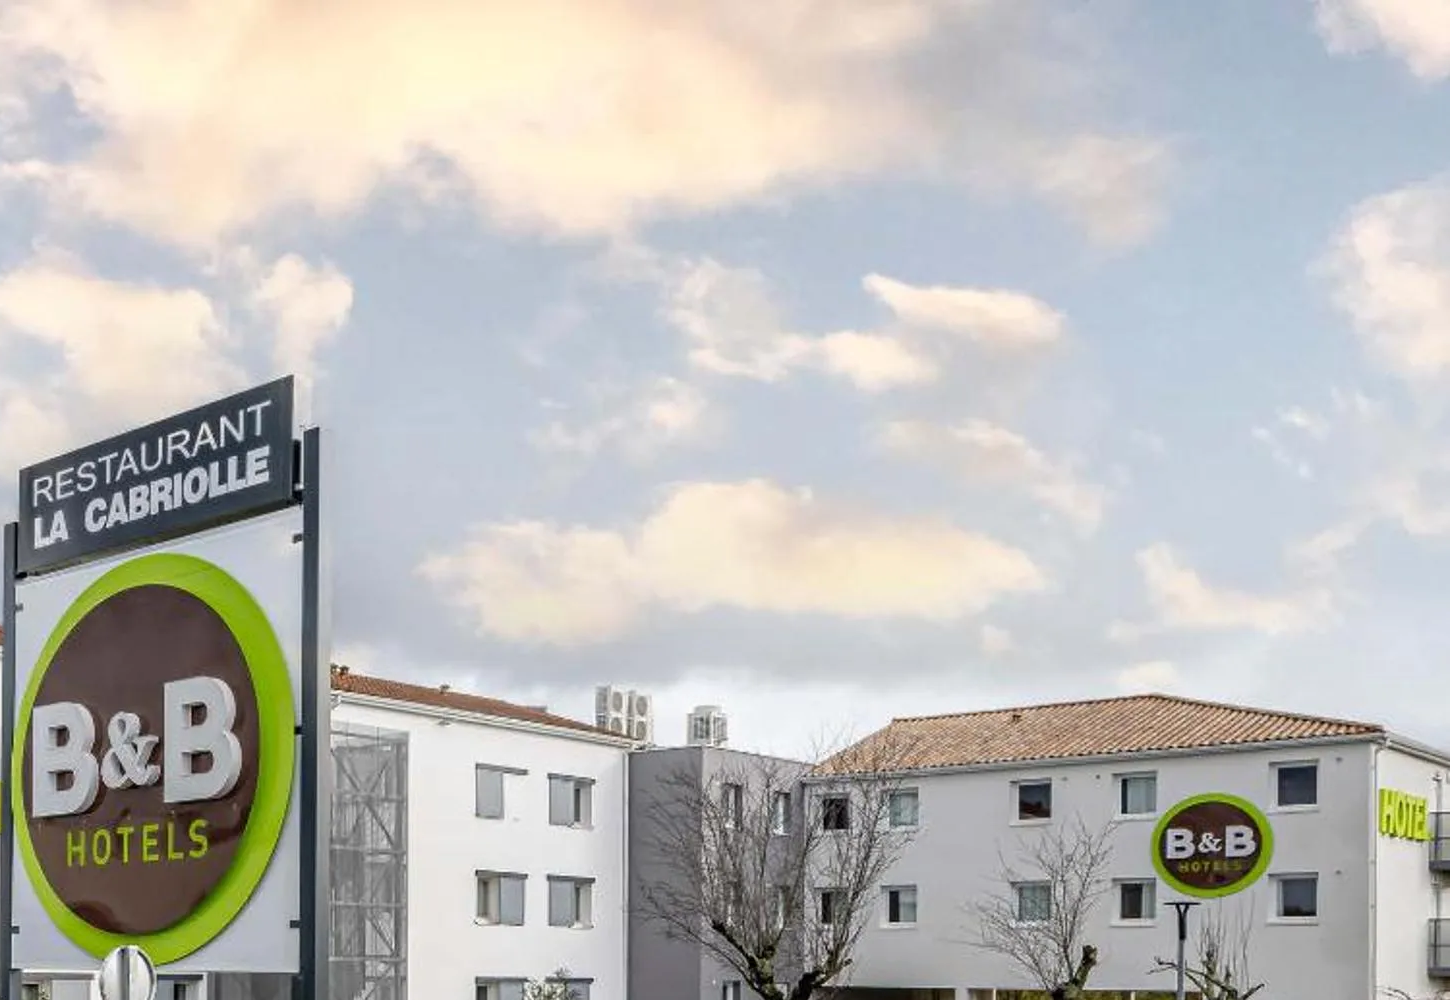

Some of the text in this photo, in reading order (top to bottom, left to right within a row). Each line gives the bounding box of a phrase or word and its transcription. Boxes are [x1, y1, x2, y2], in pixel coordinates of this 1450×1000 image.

[33, 400, 272, 507] RESTAURANT
[33, 445, 270, 550] LA CABRIOLLE
[32, 676, 243, 818] B&B
[67, 819, 209, 867] HOTELS
[1166, 825, 1256, 859] B&B
